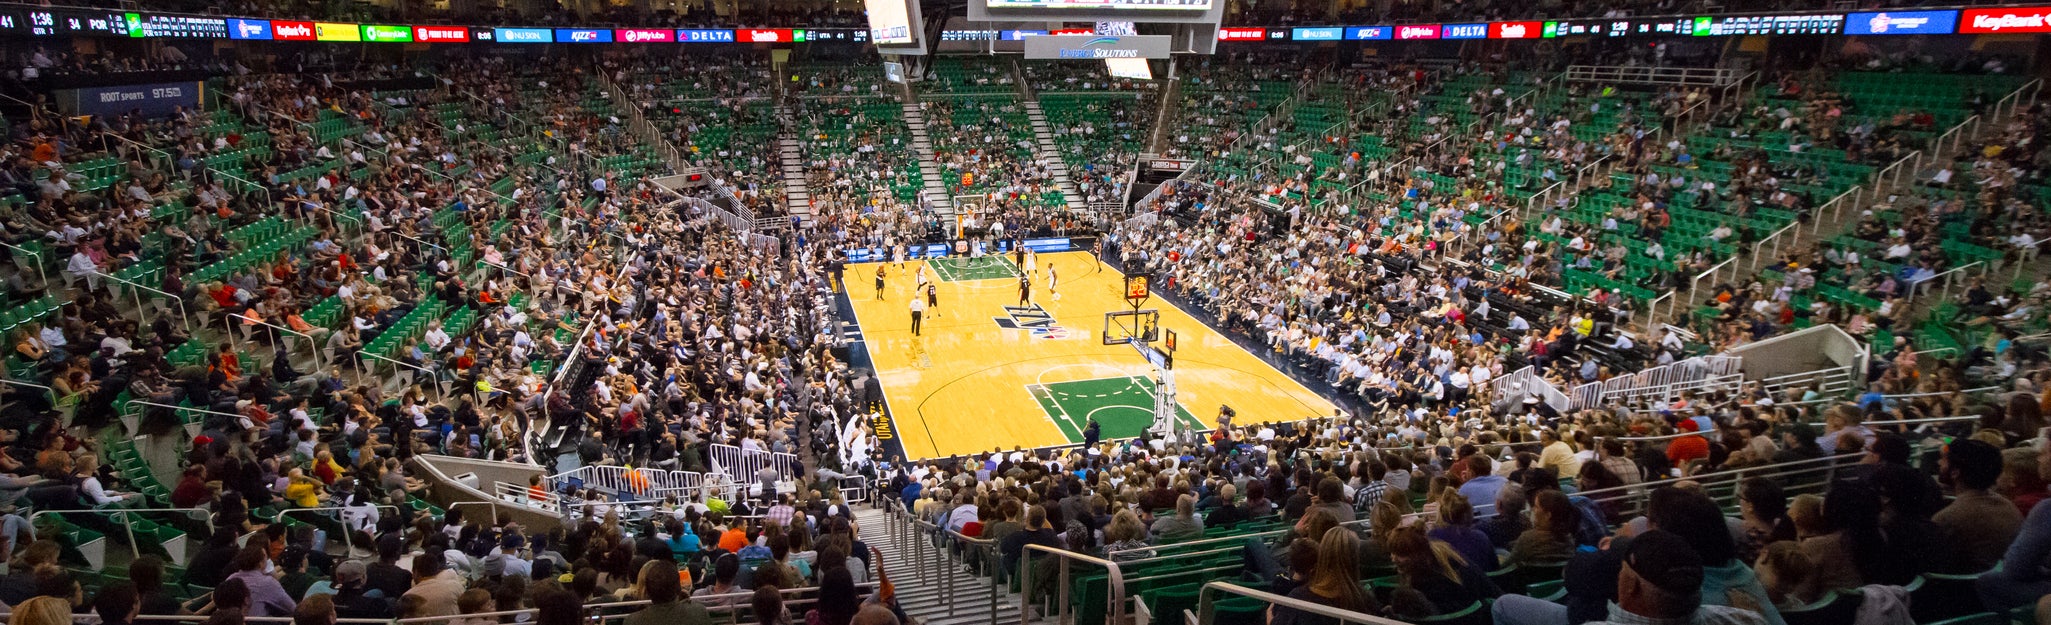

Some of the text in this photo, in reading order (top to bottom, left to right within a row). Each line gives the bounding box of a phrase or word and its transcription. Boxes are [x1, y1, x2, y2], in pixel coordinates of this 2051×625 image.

[0, 15, 14, 28] 41
[30, 11, 54, 26] 1:36
[68, 18, 81, 30] 34
[89, 18, 108, 30] POR
[1973, 14, 2044, 31] KeyBank
[1452, 26, 1486, 37] DELTA
[1656, 23, 1675, 32] POR
[691, 31, 731, 40] DELTA
[100, 91, 144, 102] ROOT SPORTS
